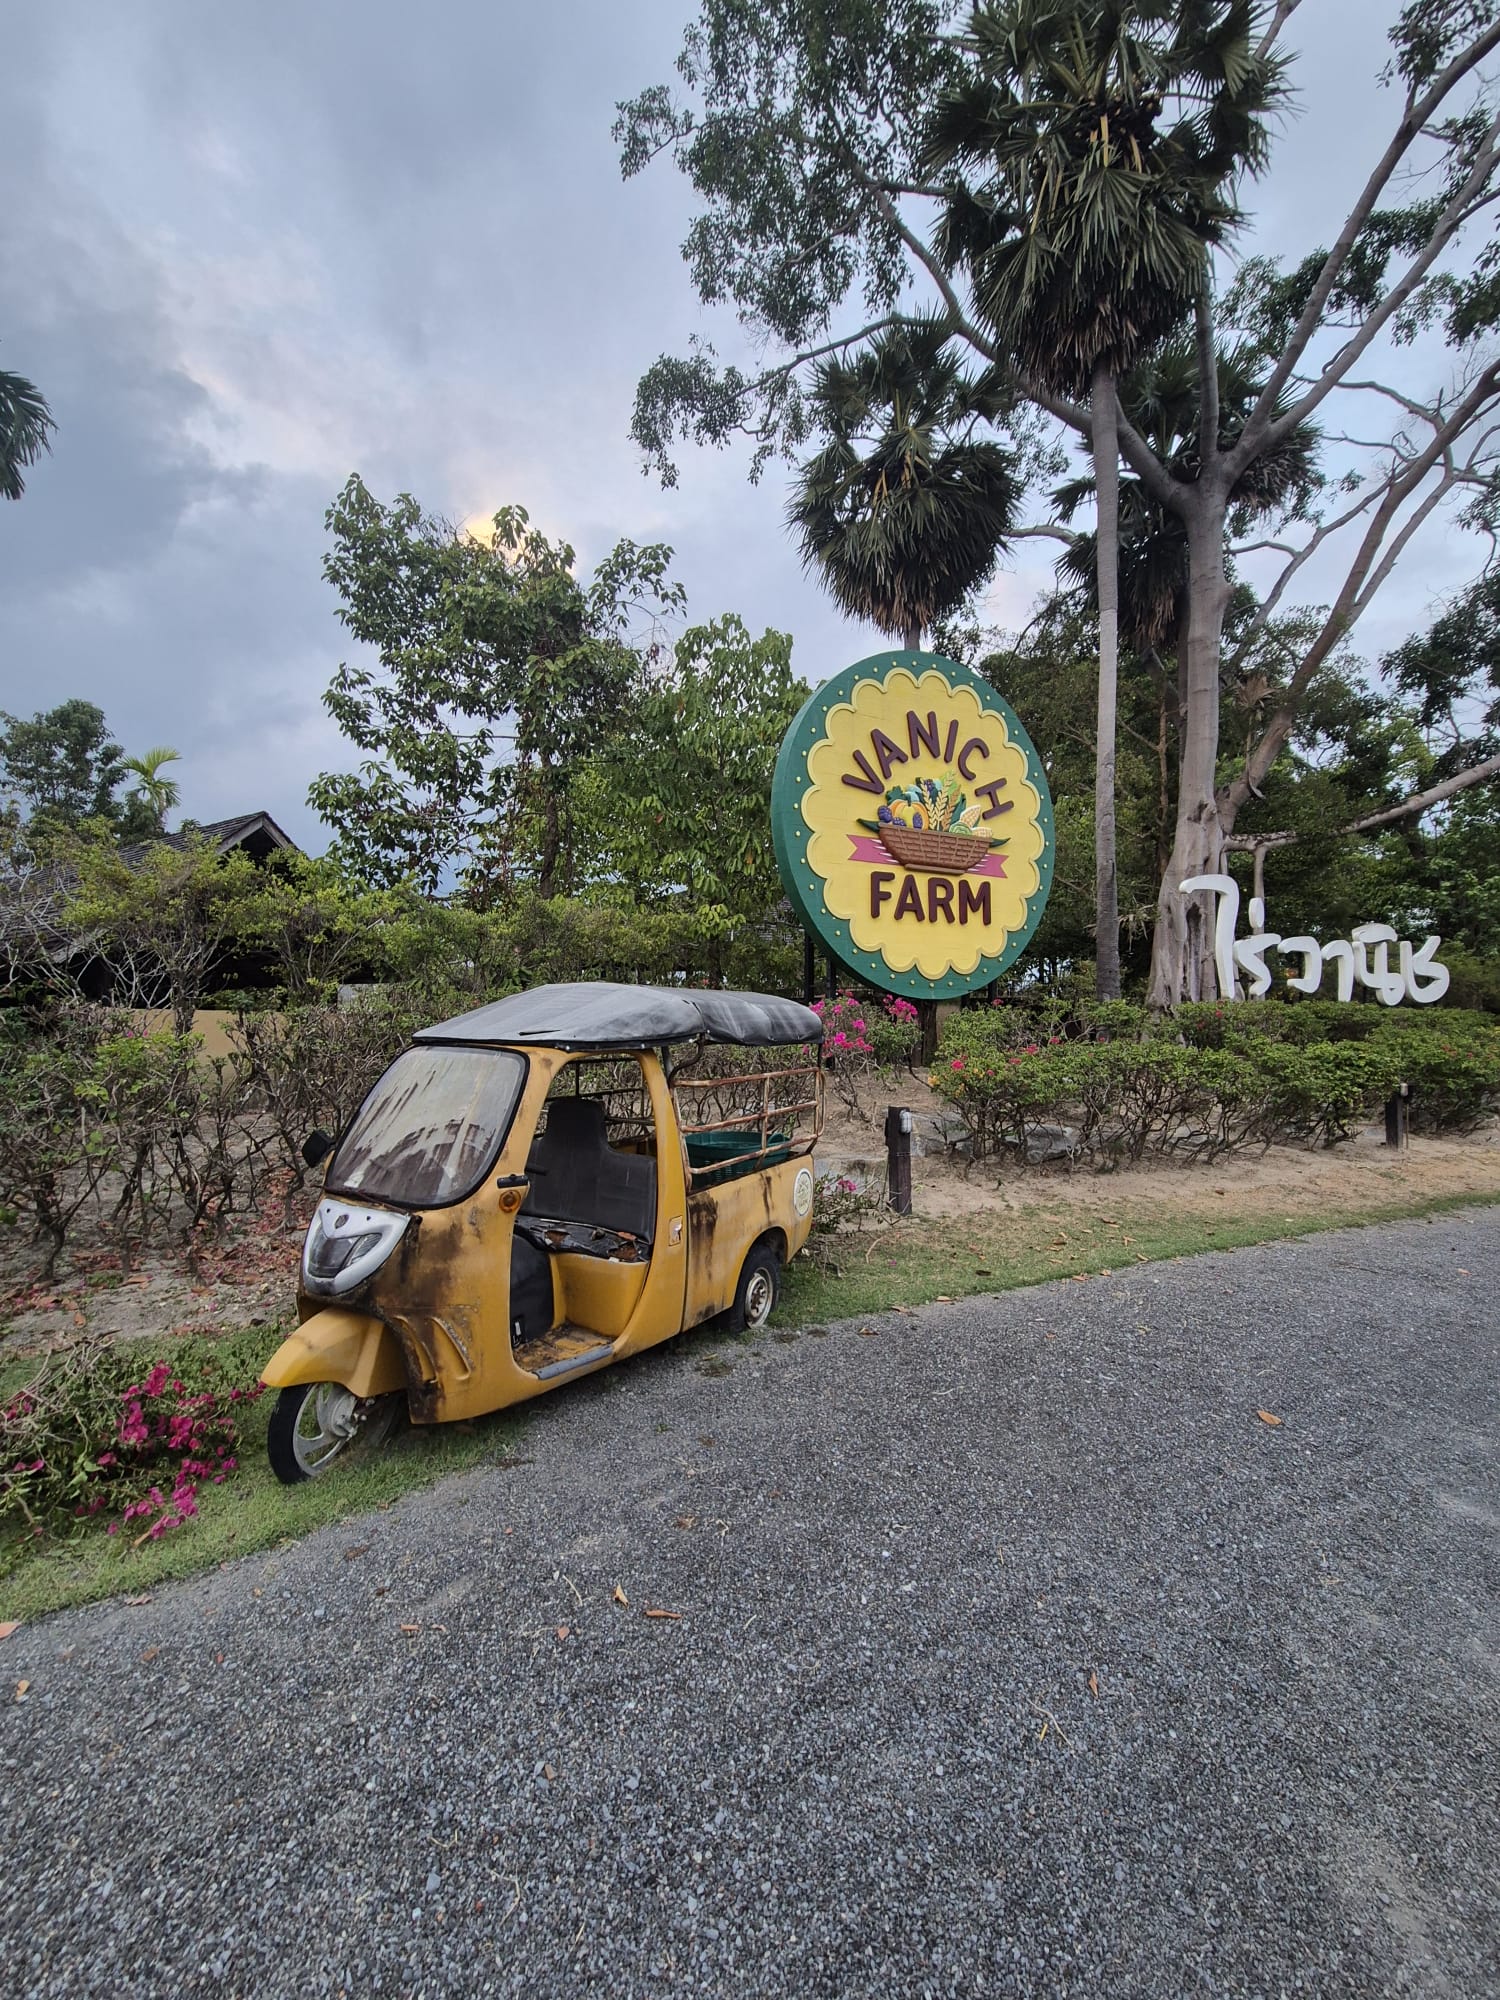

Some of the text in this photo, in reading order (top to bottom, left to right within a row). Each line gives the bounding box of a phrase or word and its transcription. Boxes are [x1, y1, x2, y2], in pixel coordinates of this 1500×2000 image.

[841, 710, 1014, 820] VANICH
[870, 871, 992, 926] FARM
[1178, 874, 1450, 1006] ไร่วานิช
